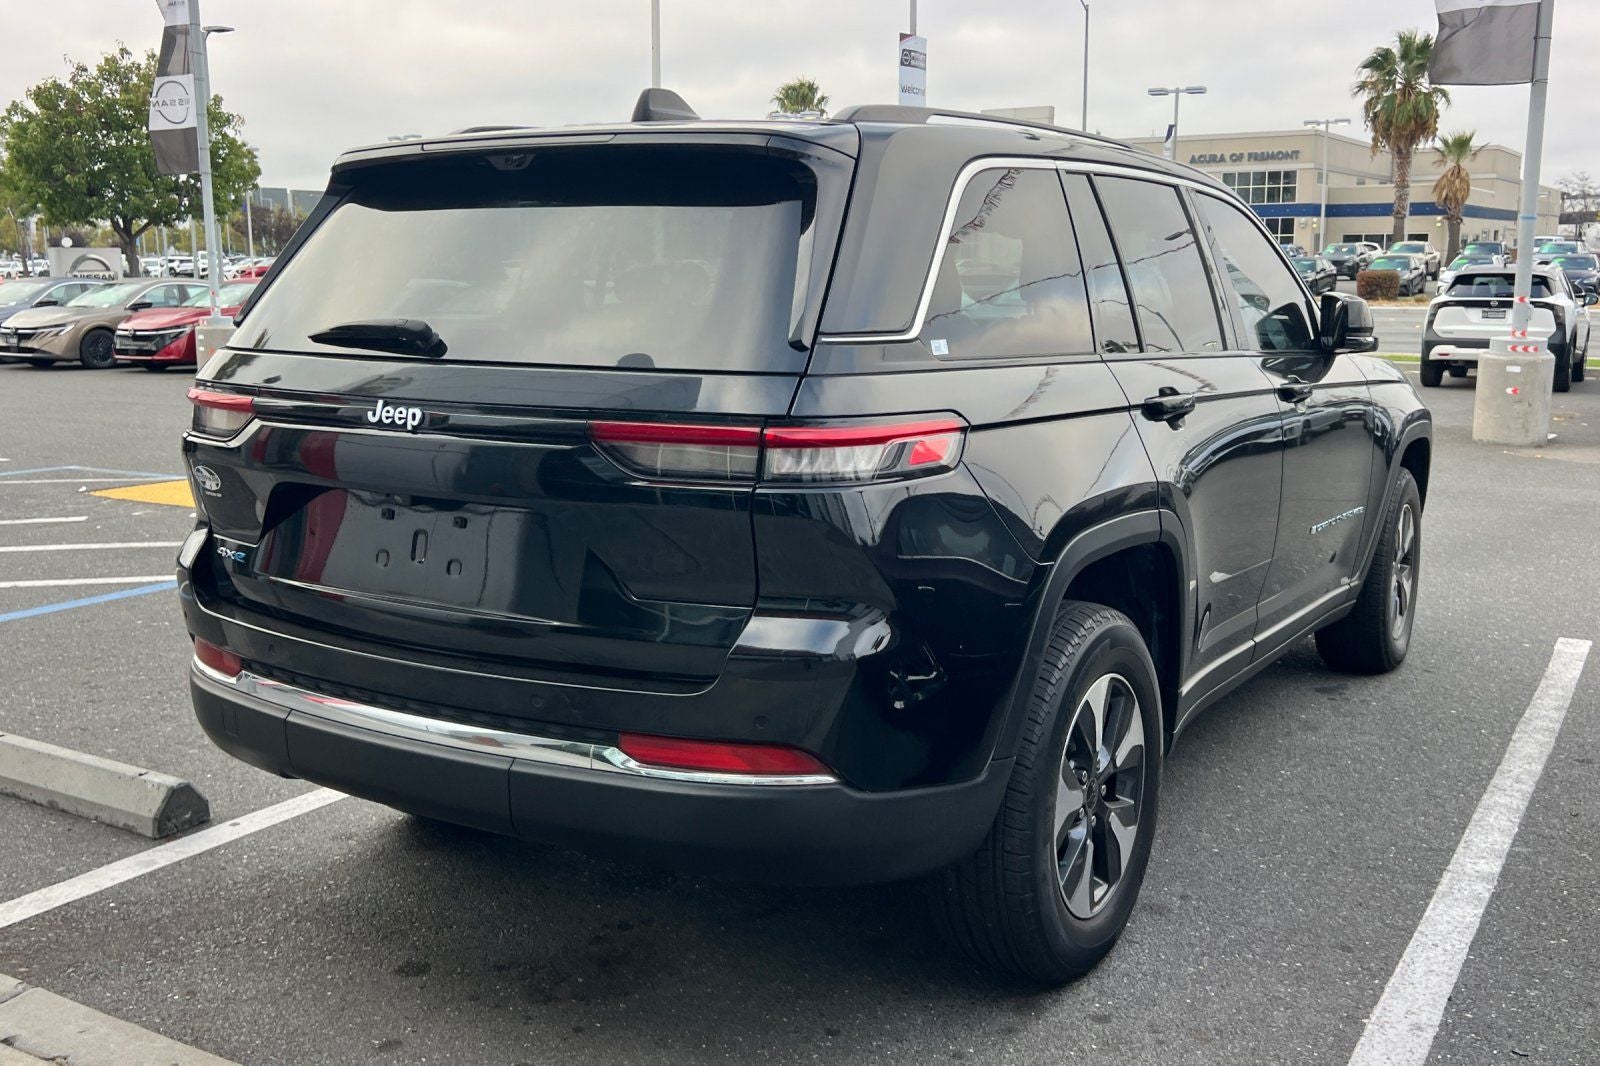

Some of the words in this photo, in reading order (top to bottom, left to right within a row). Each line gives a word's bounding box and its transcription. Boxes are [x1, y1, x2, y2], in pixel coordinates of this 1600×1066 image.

[1189, 153, 1227, 164] ACURA
[1229, 152, 1245, 163] OF
[1247, 149, 1301, 162] FREMONT
[367, 399, 422, 430] Jeep
